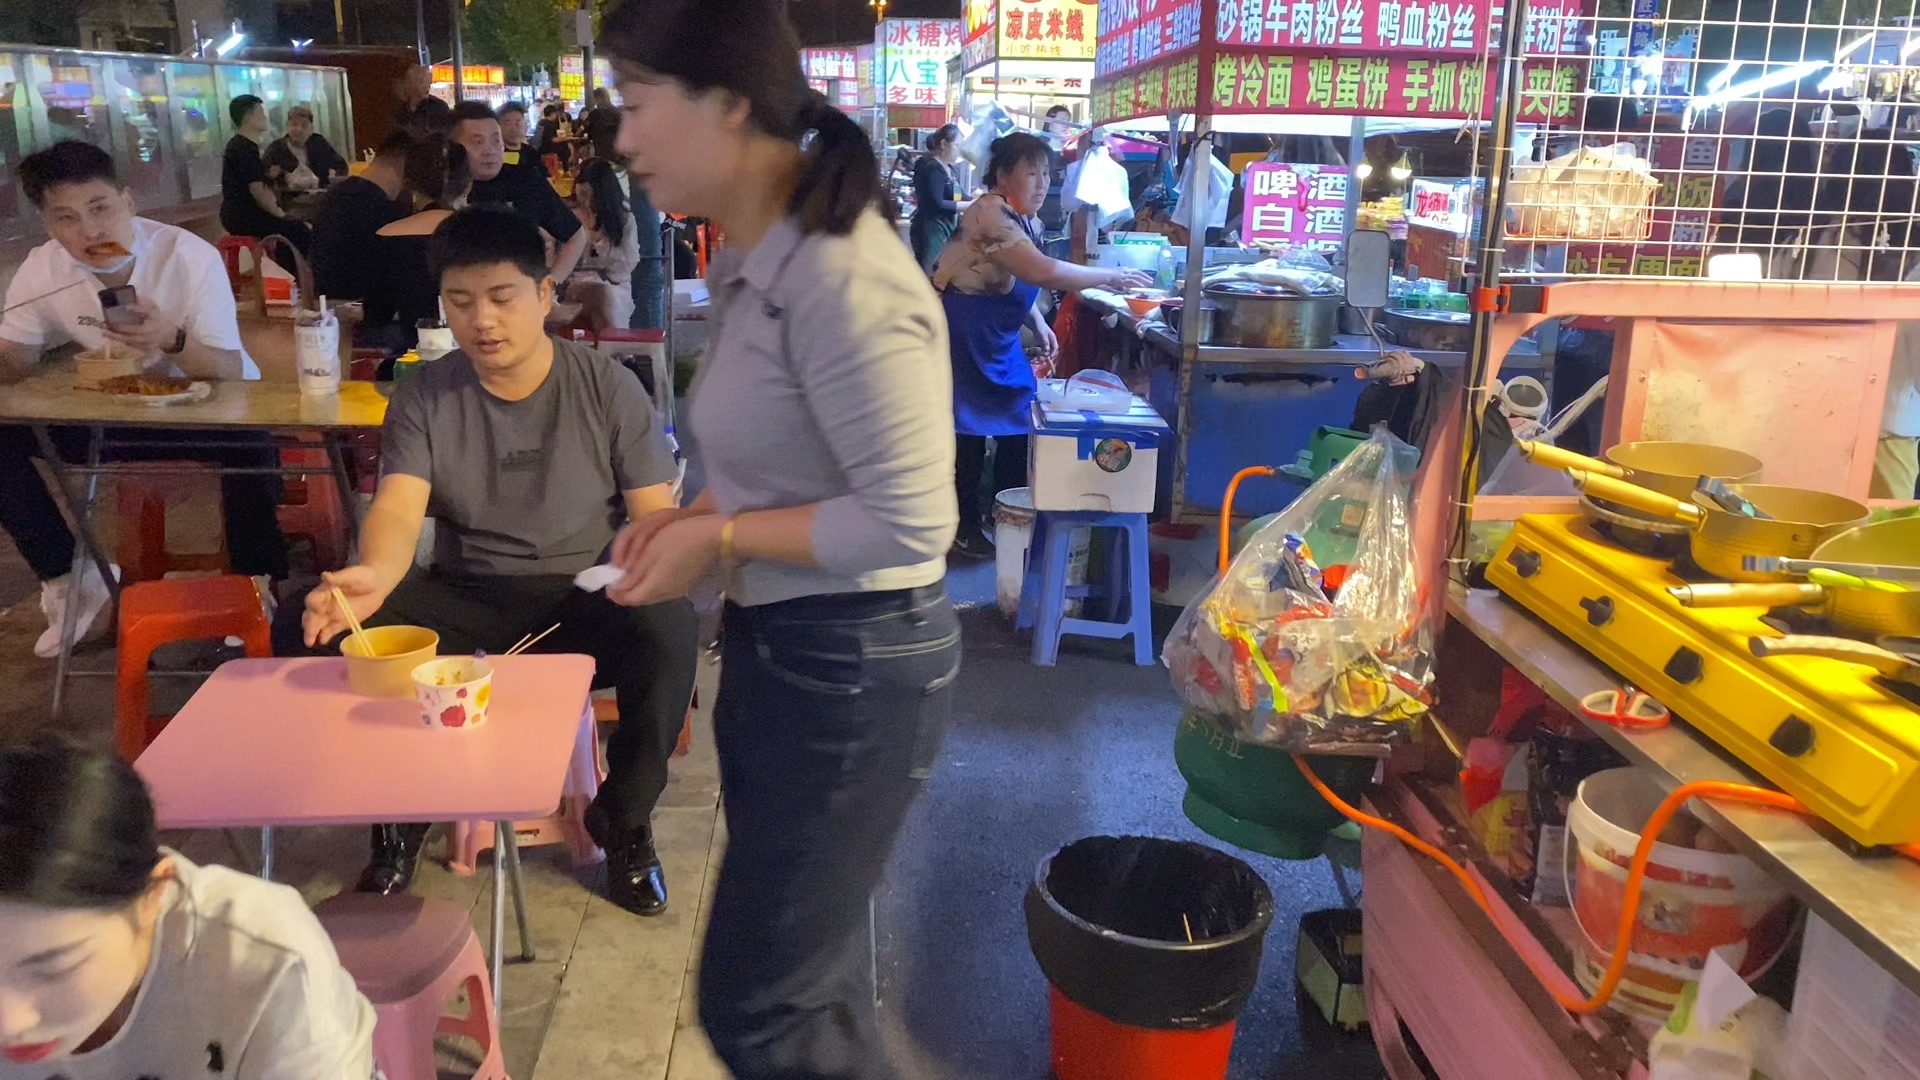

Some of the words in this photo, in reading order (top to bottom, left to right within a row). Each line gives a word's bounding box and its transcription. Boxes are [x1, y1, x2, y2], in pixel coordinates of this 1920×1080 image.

[1006, 7, 1084, 41] 凉皮米线
[1216, 0, 1364, 44] 砂锅牛肉粉丝
[1377, 0, 1475, 48] 鸭血粉丝
[888, 59, 938, 85] 八宝
[1212, 52, 1293, 107] 烤冷面
[1306, 55, 1389, 110] 鸡蛋饼
[1402, 58, 1484, 113] 手抓饼
[1516, 64, 1580, 117] 夹馍
[888, 85, 937, 105] 多味
[1253, 169, 1348, 201] 啤酒
[1251, 203, 1345, 235] 白酒
